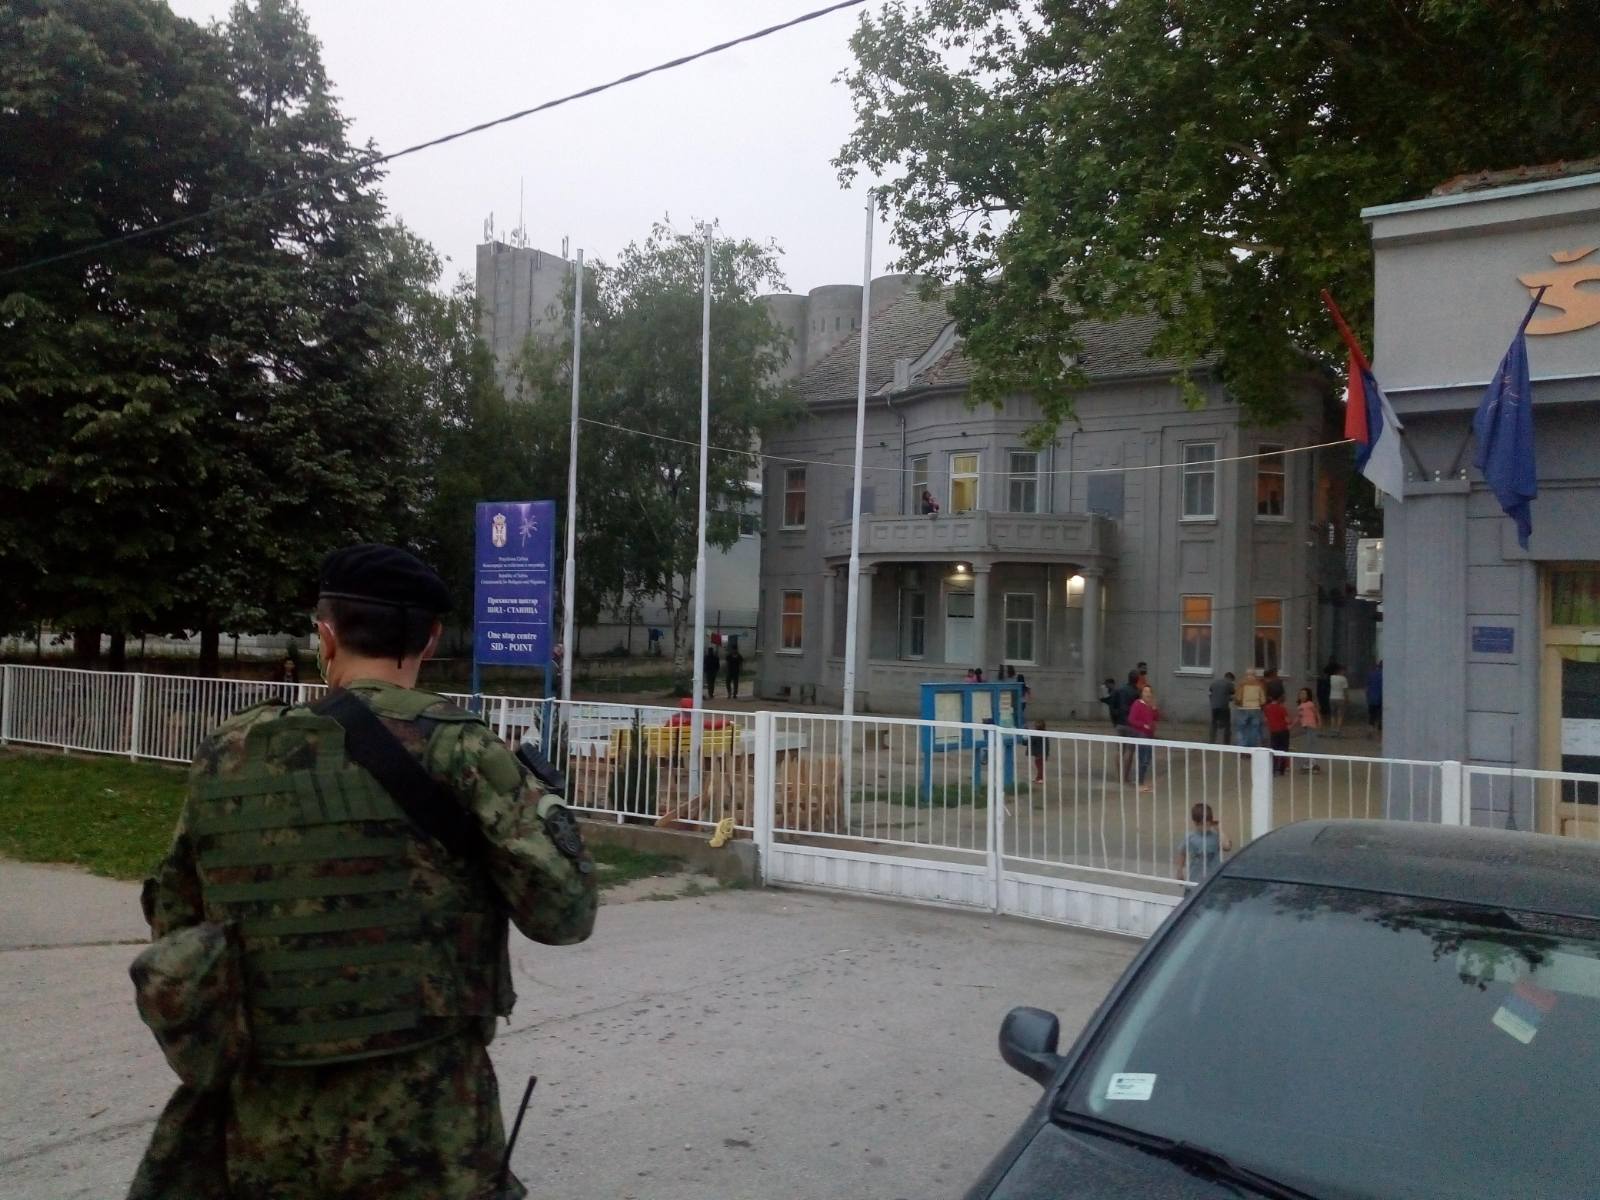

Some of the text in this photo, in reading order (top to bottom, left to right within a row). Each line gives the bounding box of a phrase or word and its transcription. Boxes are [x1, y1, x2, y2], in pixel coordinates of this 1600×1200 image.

[488, 631, 501, 639] One
[502, 632, 515, 640] stop
[491, 642, 503, 650] SID
[509, 643, 532, 651] POINT
